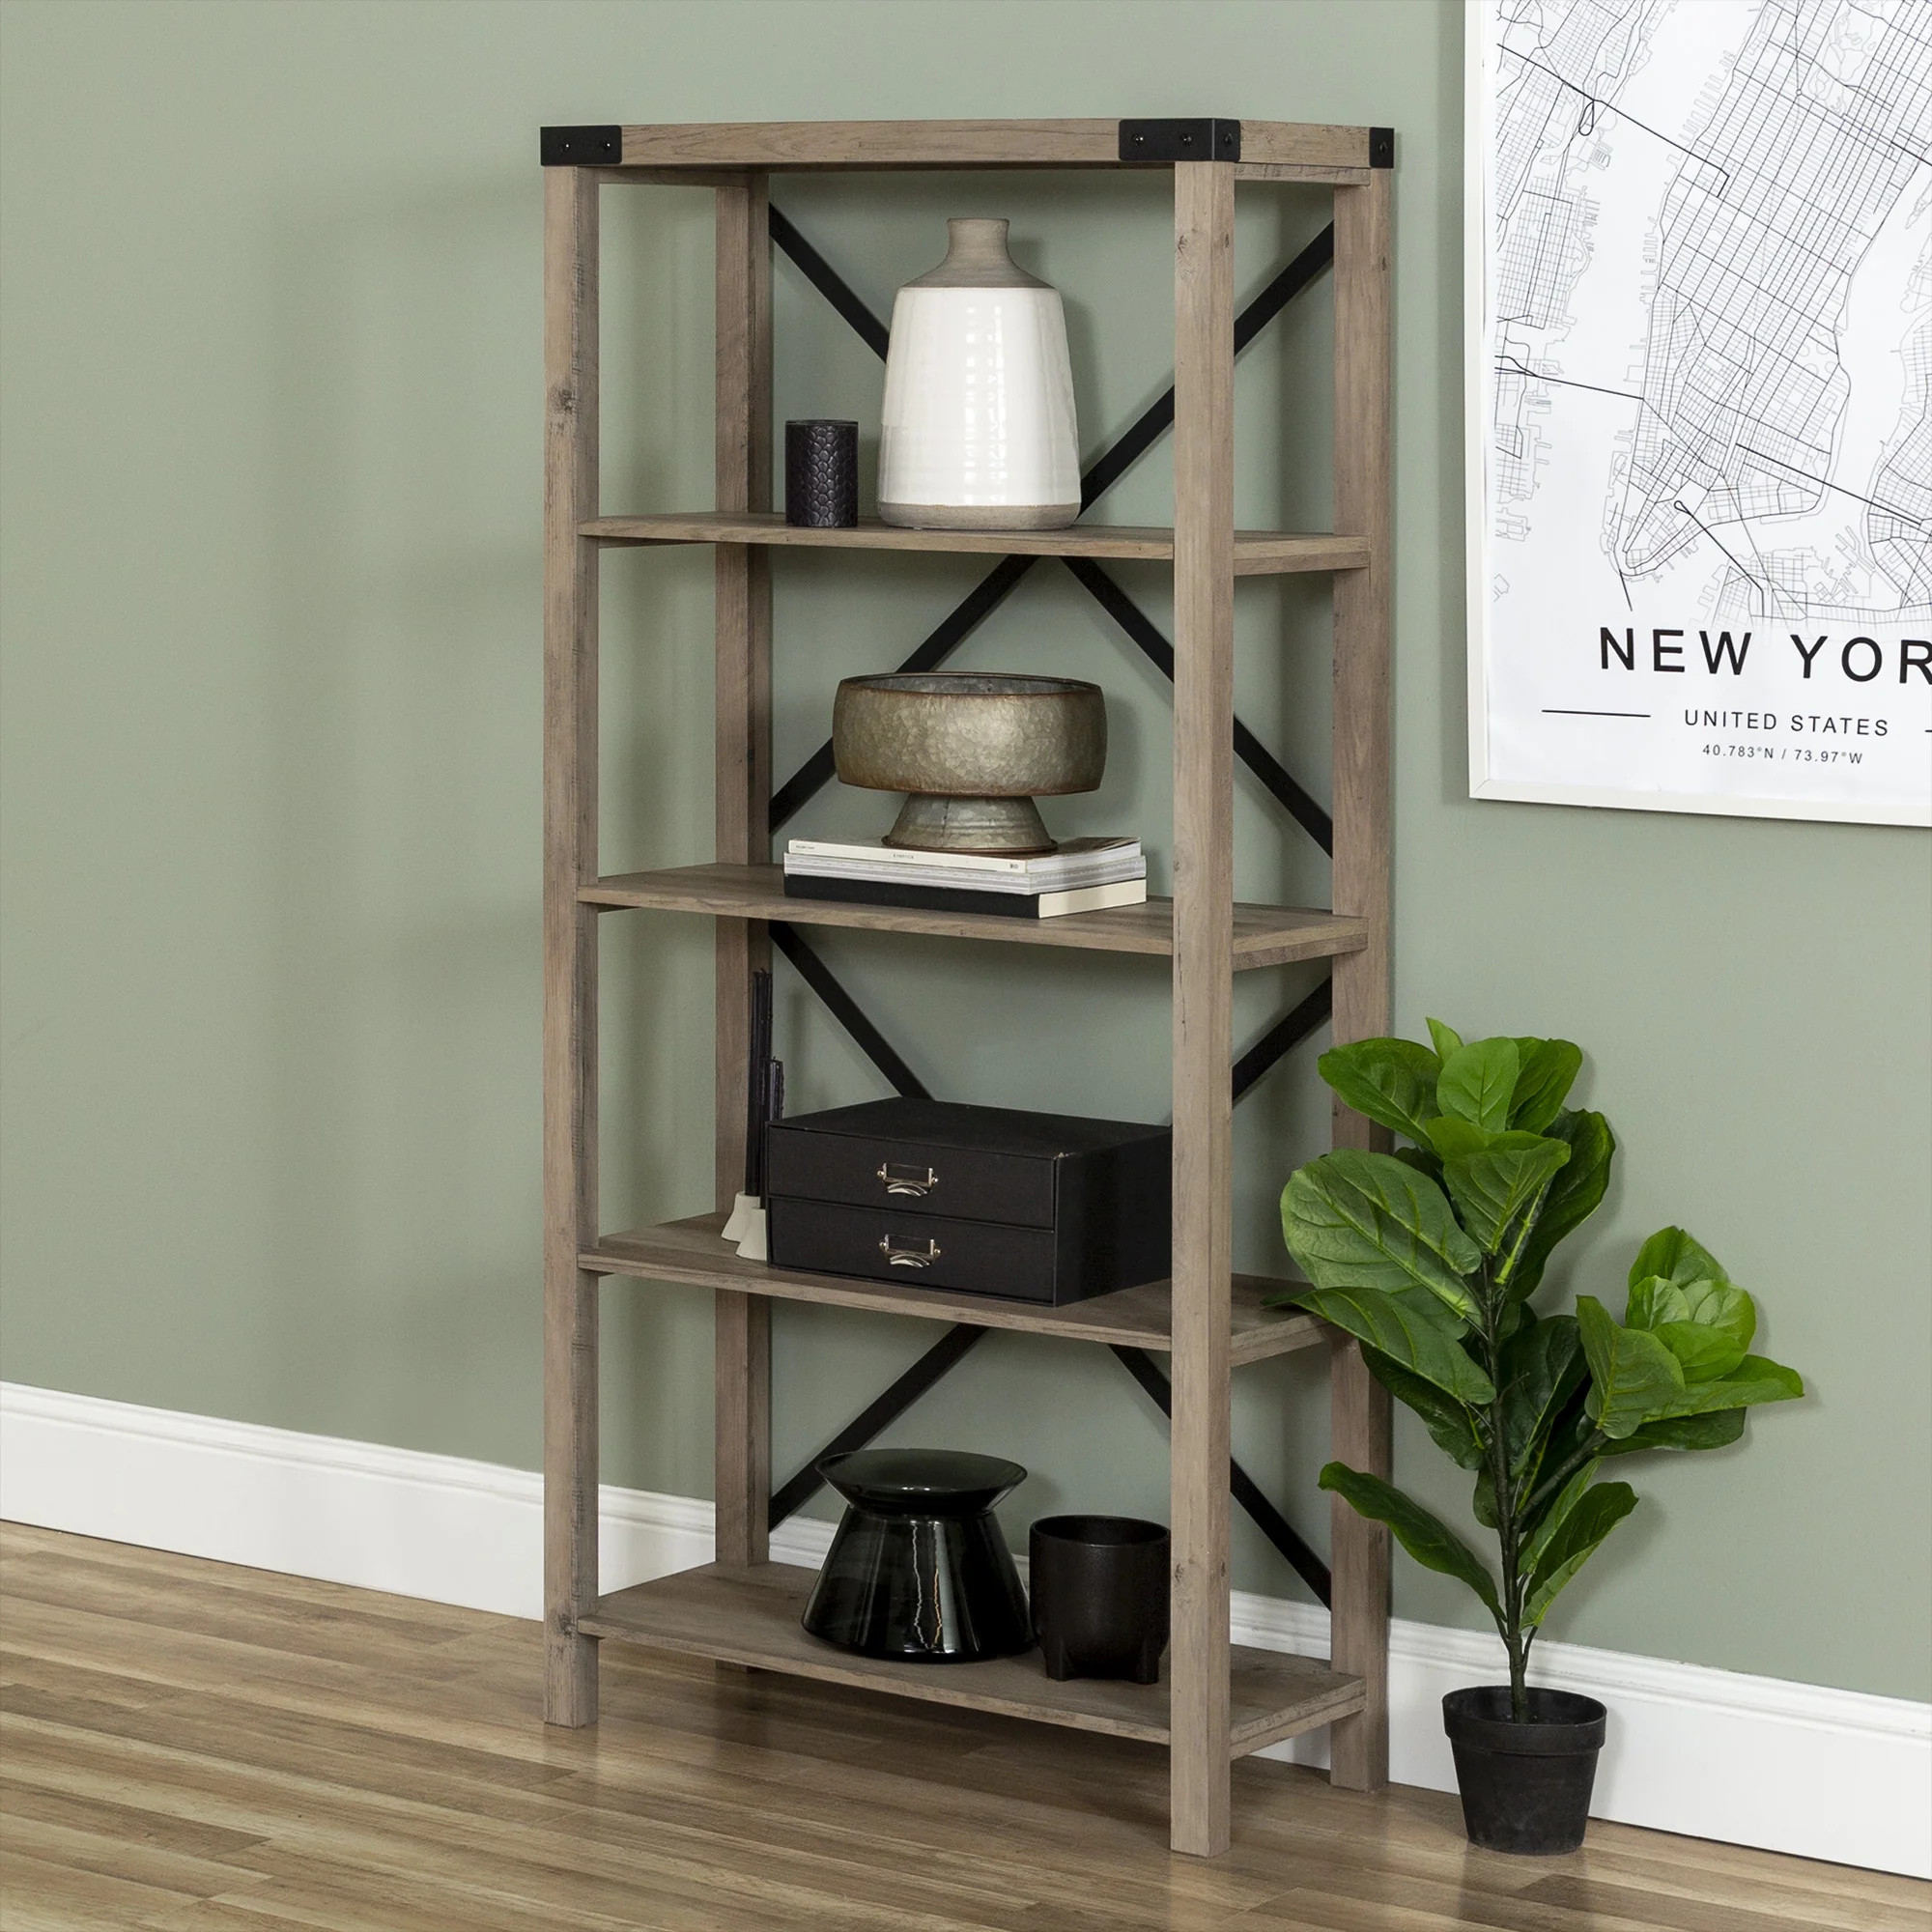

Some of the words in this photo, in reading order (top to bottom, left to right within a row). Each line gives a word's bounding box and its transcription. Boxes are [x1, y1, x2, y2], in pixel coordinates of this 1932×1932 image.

[1600, 626, 1752, 676] NEW
[1789, 634, 1932, 686] YOR
[1685, 709, 1777, 731] UNITED
[1790, 714, 1889, 737] STATES
